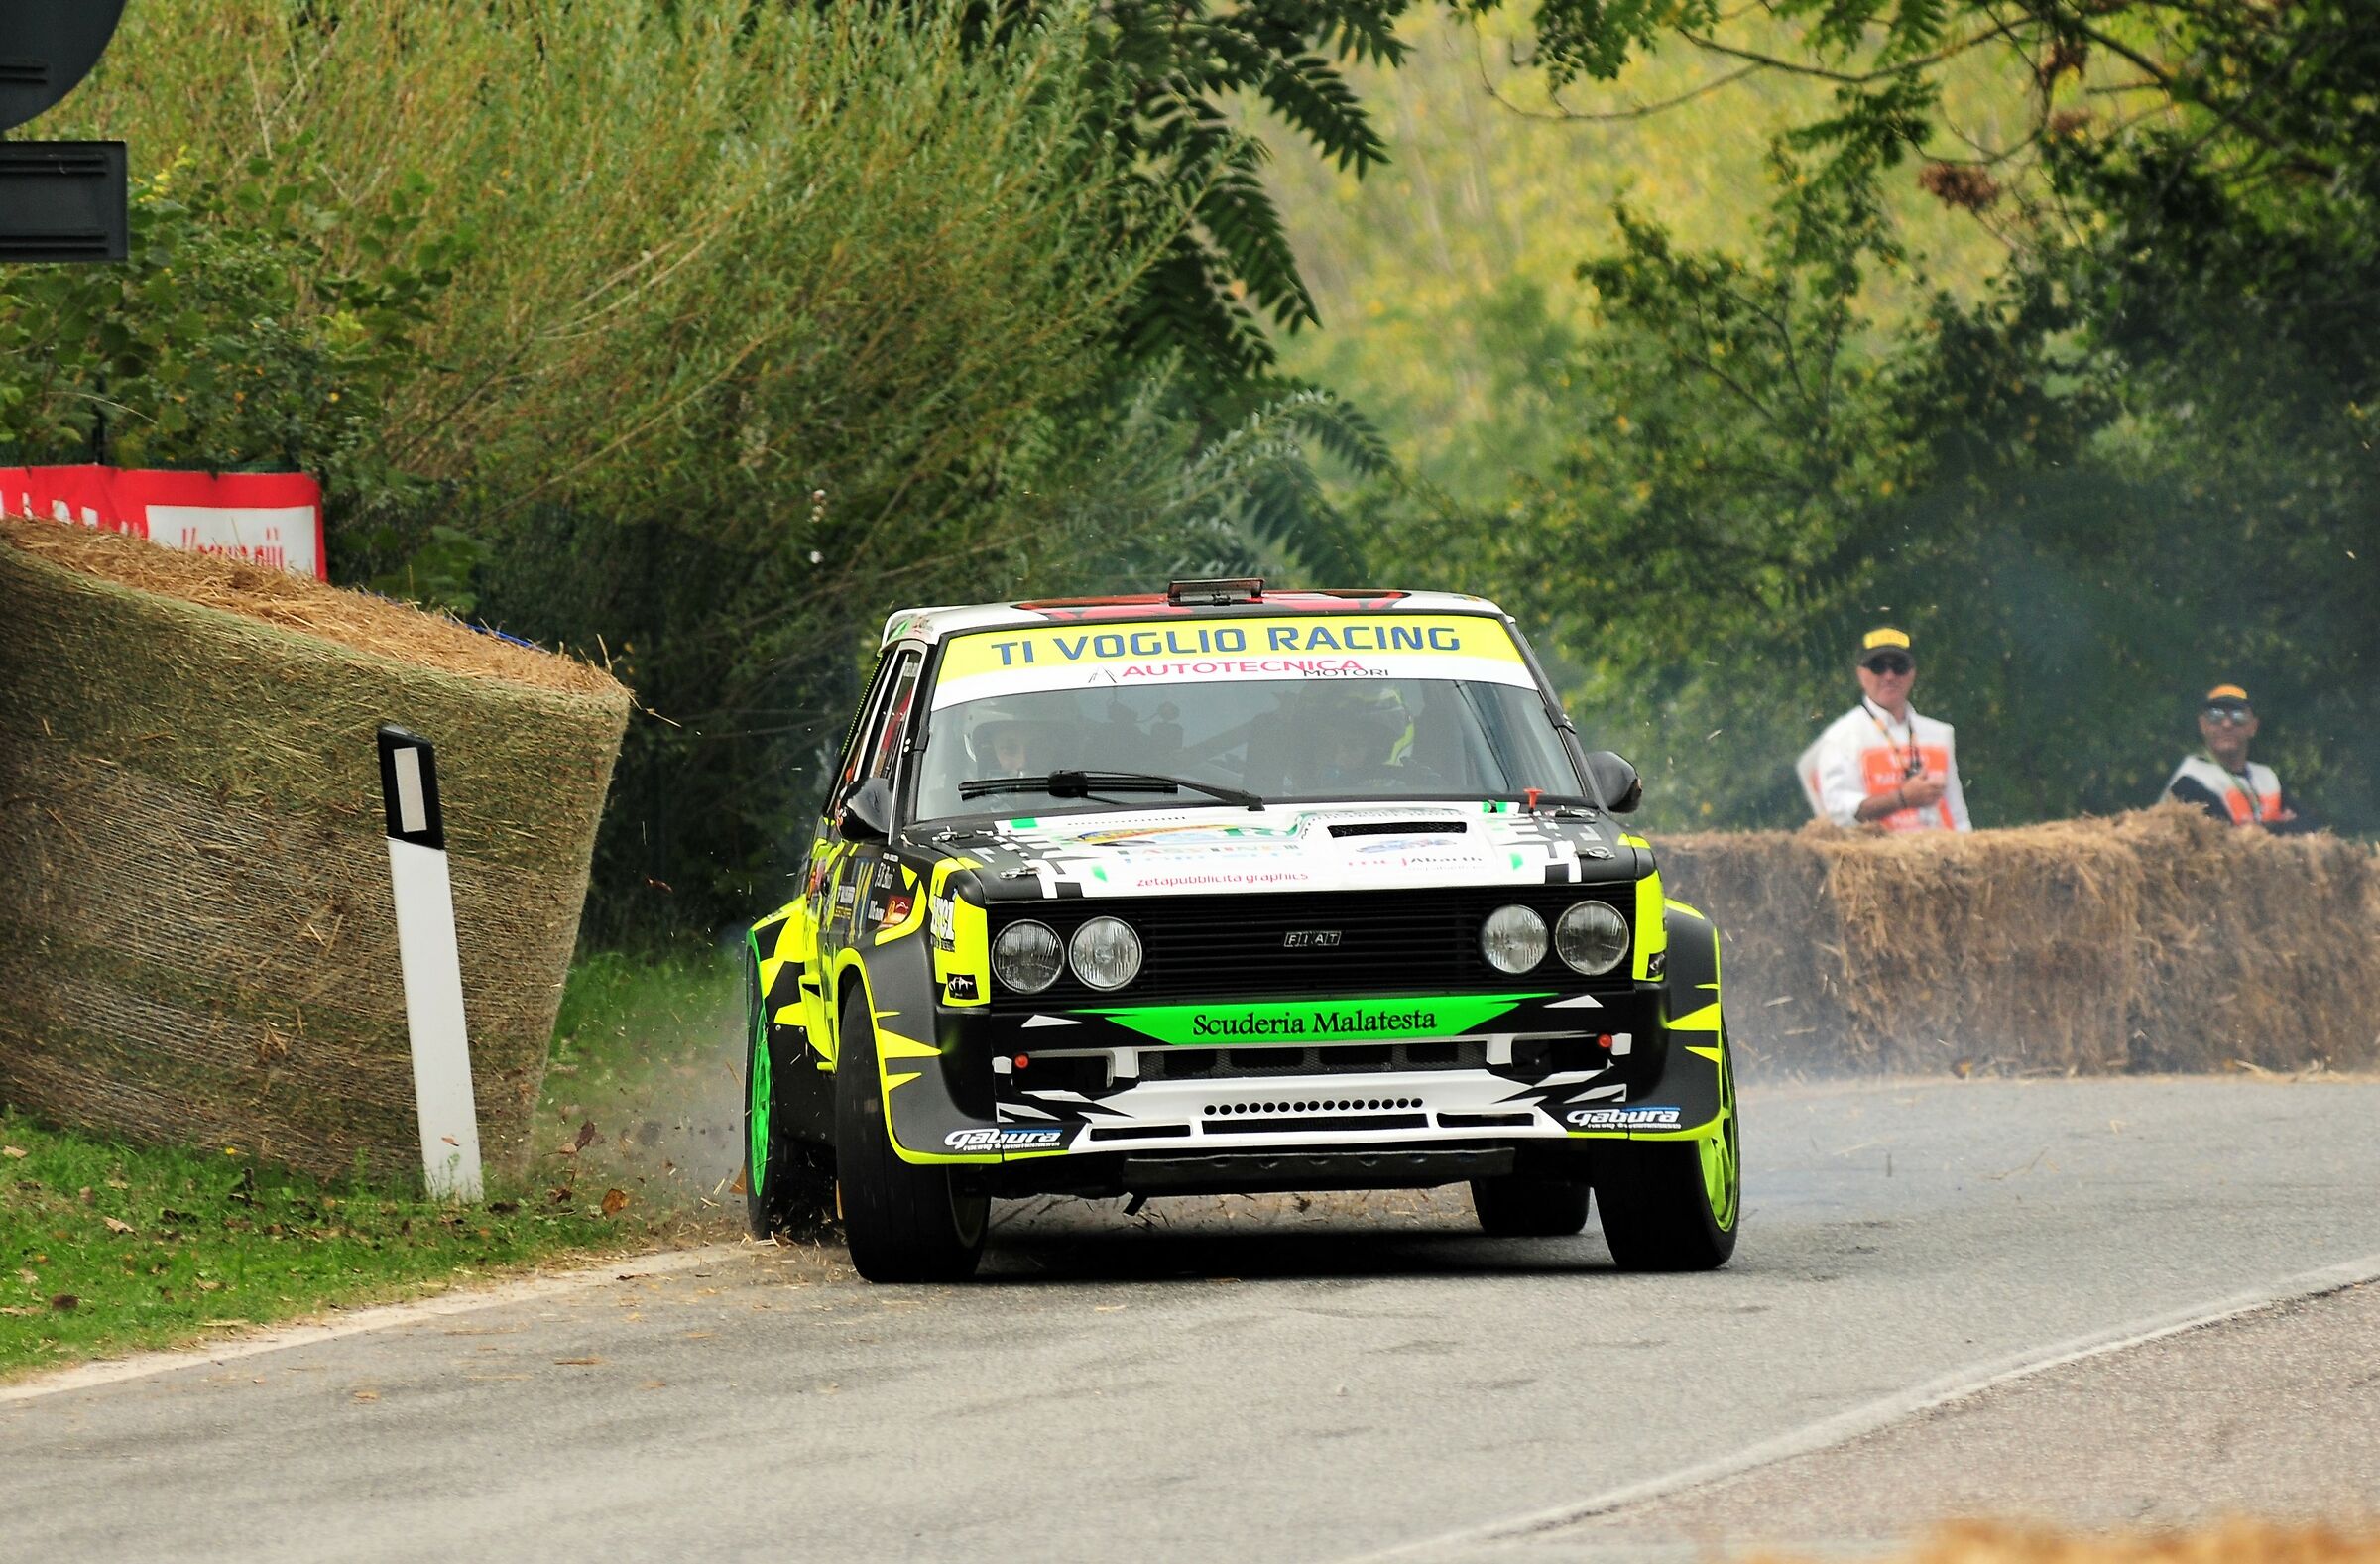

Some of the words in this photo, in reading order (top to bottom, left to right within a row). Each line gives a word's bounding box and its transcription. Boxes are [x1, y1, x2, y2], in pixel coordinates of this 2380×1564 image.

[992, 641, 1034, 665] TI
[1053, 628, 1247, 661] VOGLIO
[1267, 626, 1461, 651] RACING
[1122, 660, 1363, 677] AUTOTECNICA
[1303, 668, 1389, 677] MOTORI
[1286, 932, 1340, 945] FIAT
[1193, 1012, 1305, 1036] Scuderia
[1313, 1010, 1438, 1034] Malatesta
